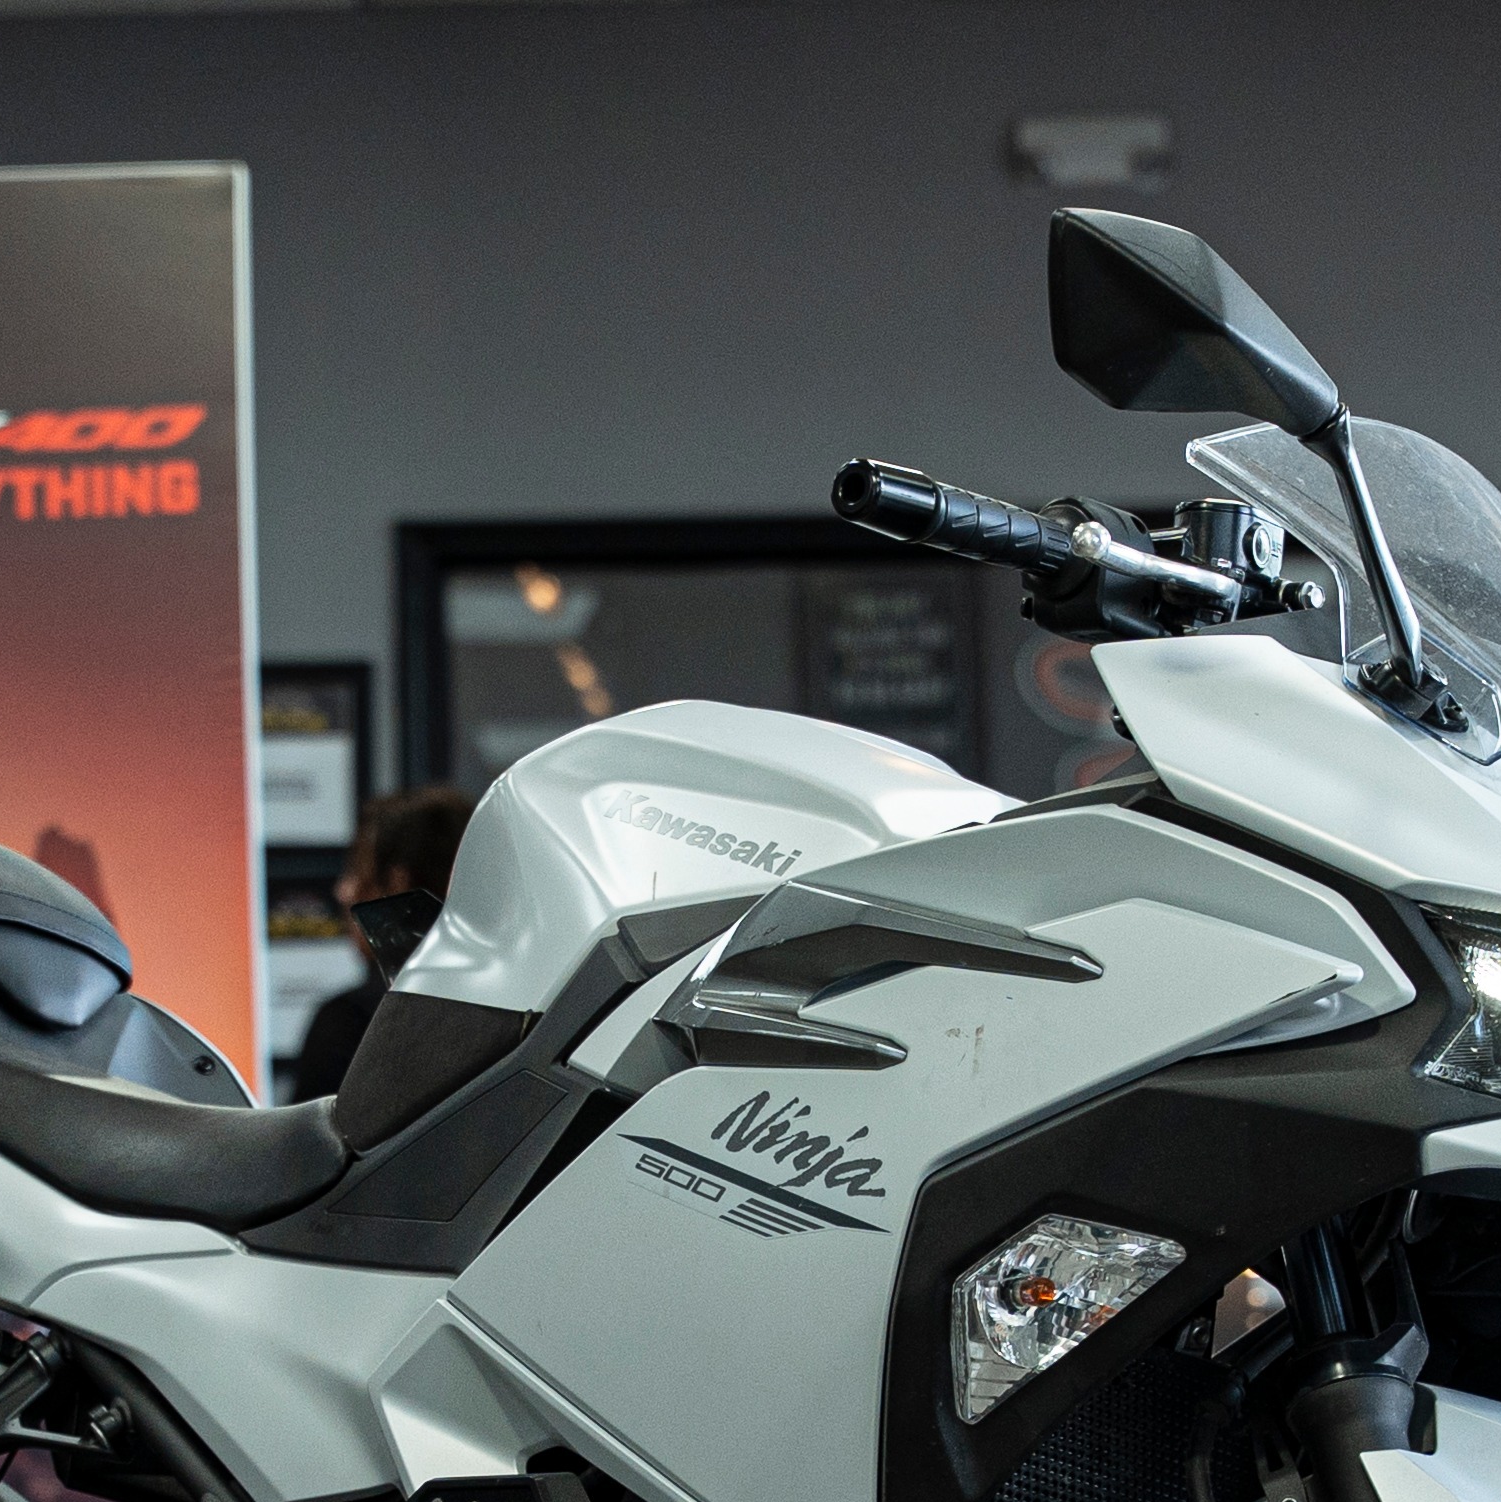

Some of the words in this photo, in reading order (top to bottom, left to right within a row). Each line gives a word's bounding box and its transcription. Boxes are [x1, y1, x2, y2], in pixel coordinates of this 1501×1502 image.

[603, 789, 802, 877] Kawasaki
[634, 1153, 726, 1203] 500
[710, 1090, 886, 1198] Ninja
